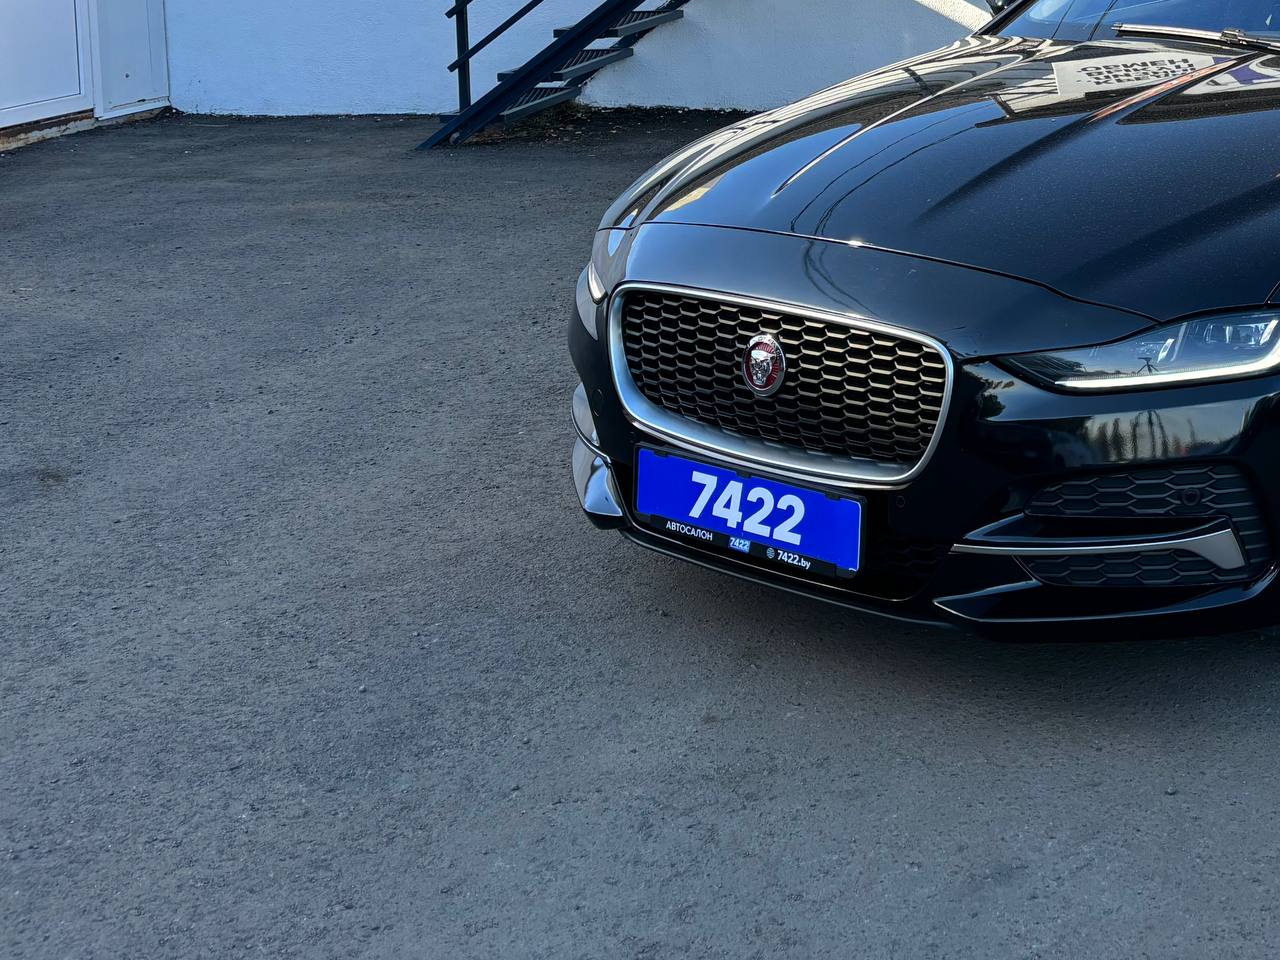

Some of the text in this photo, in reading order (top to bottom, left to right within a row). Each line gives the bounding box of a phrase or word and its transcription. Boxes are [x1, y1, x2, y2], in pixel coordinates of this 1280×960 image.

[688, 470, 806, 546] 7422
[665, 520, 713, 541] АВТОСАЛОН
[729, 537, 750, 551] 7422
[777, 549, 811, 570] 7422.by
